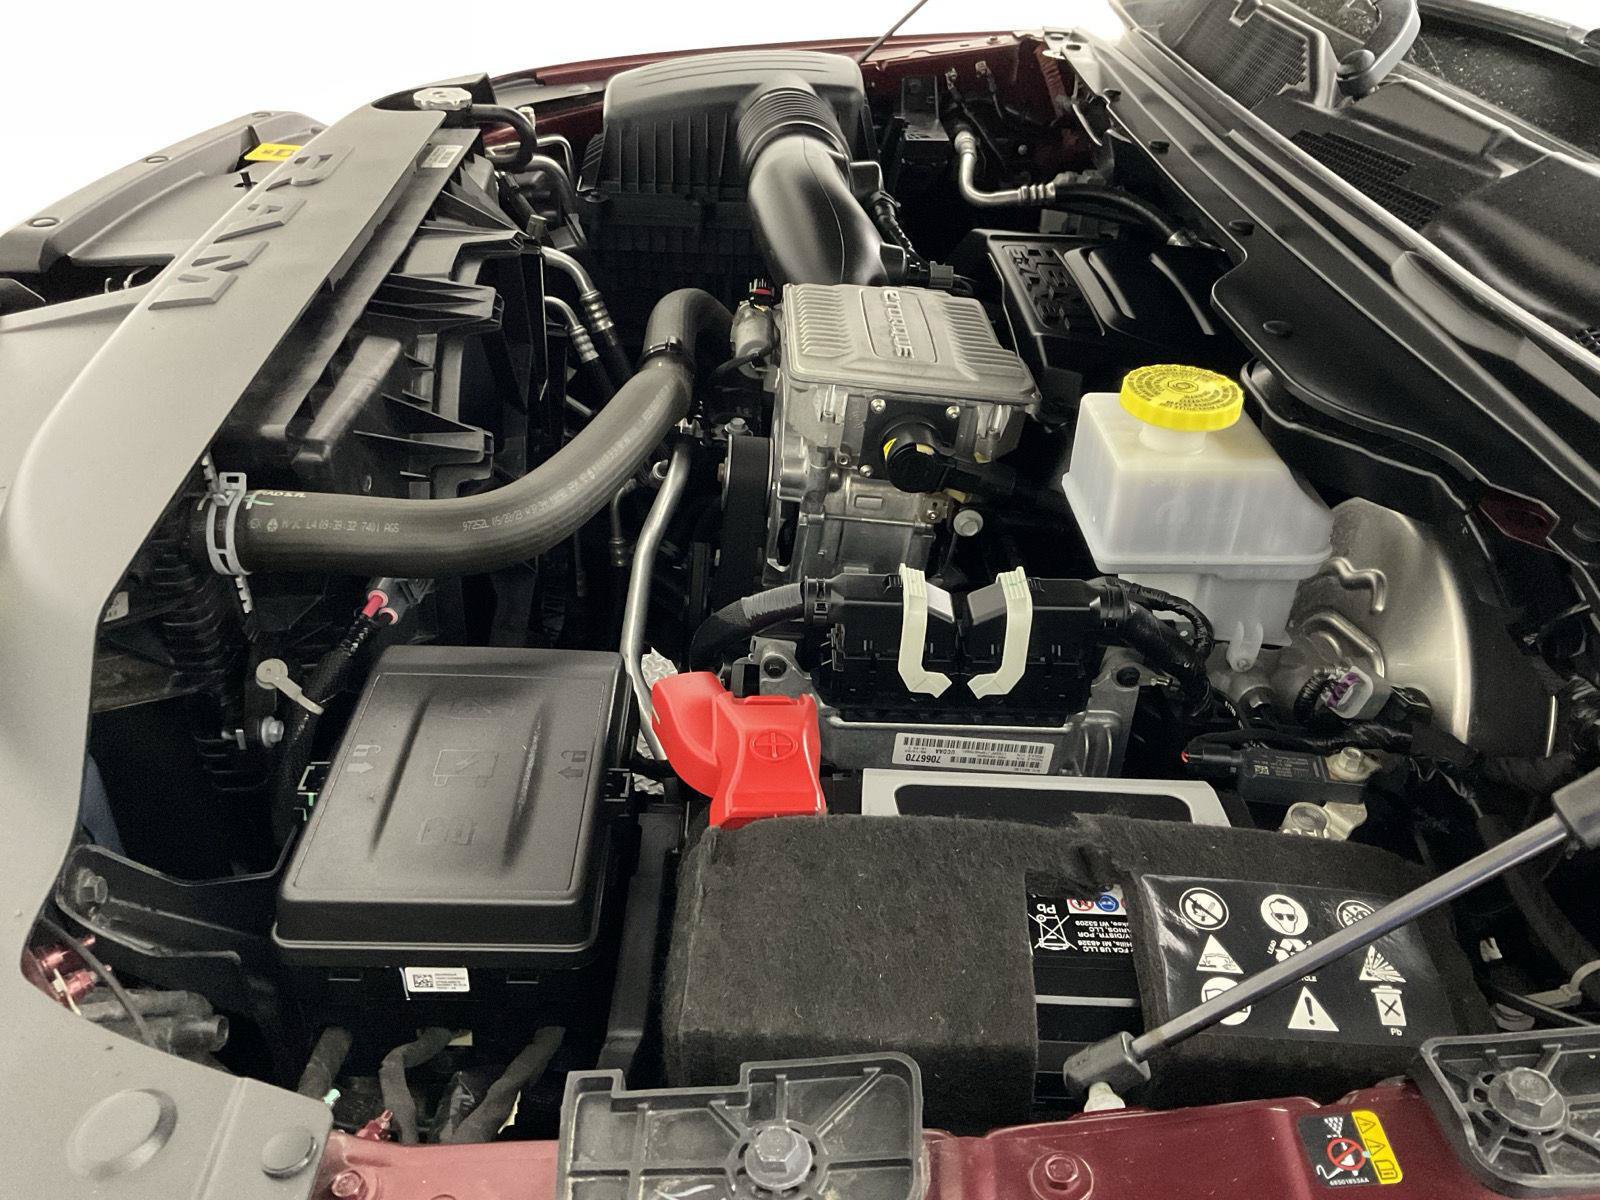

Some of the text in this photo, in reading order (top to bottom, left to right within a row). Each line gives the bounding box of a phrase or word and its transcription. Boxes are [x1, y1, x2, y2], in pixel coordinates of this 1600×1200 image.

[148, 146, 352, 311] RAM
[905, 753, 941, 764] 7066770
[1037, 903, 1057, 914] Pb
[1390, 1027, 1403, 1036] Pb
